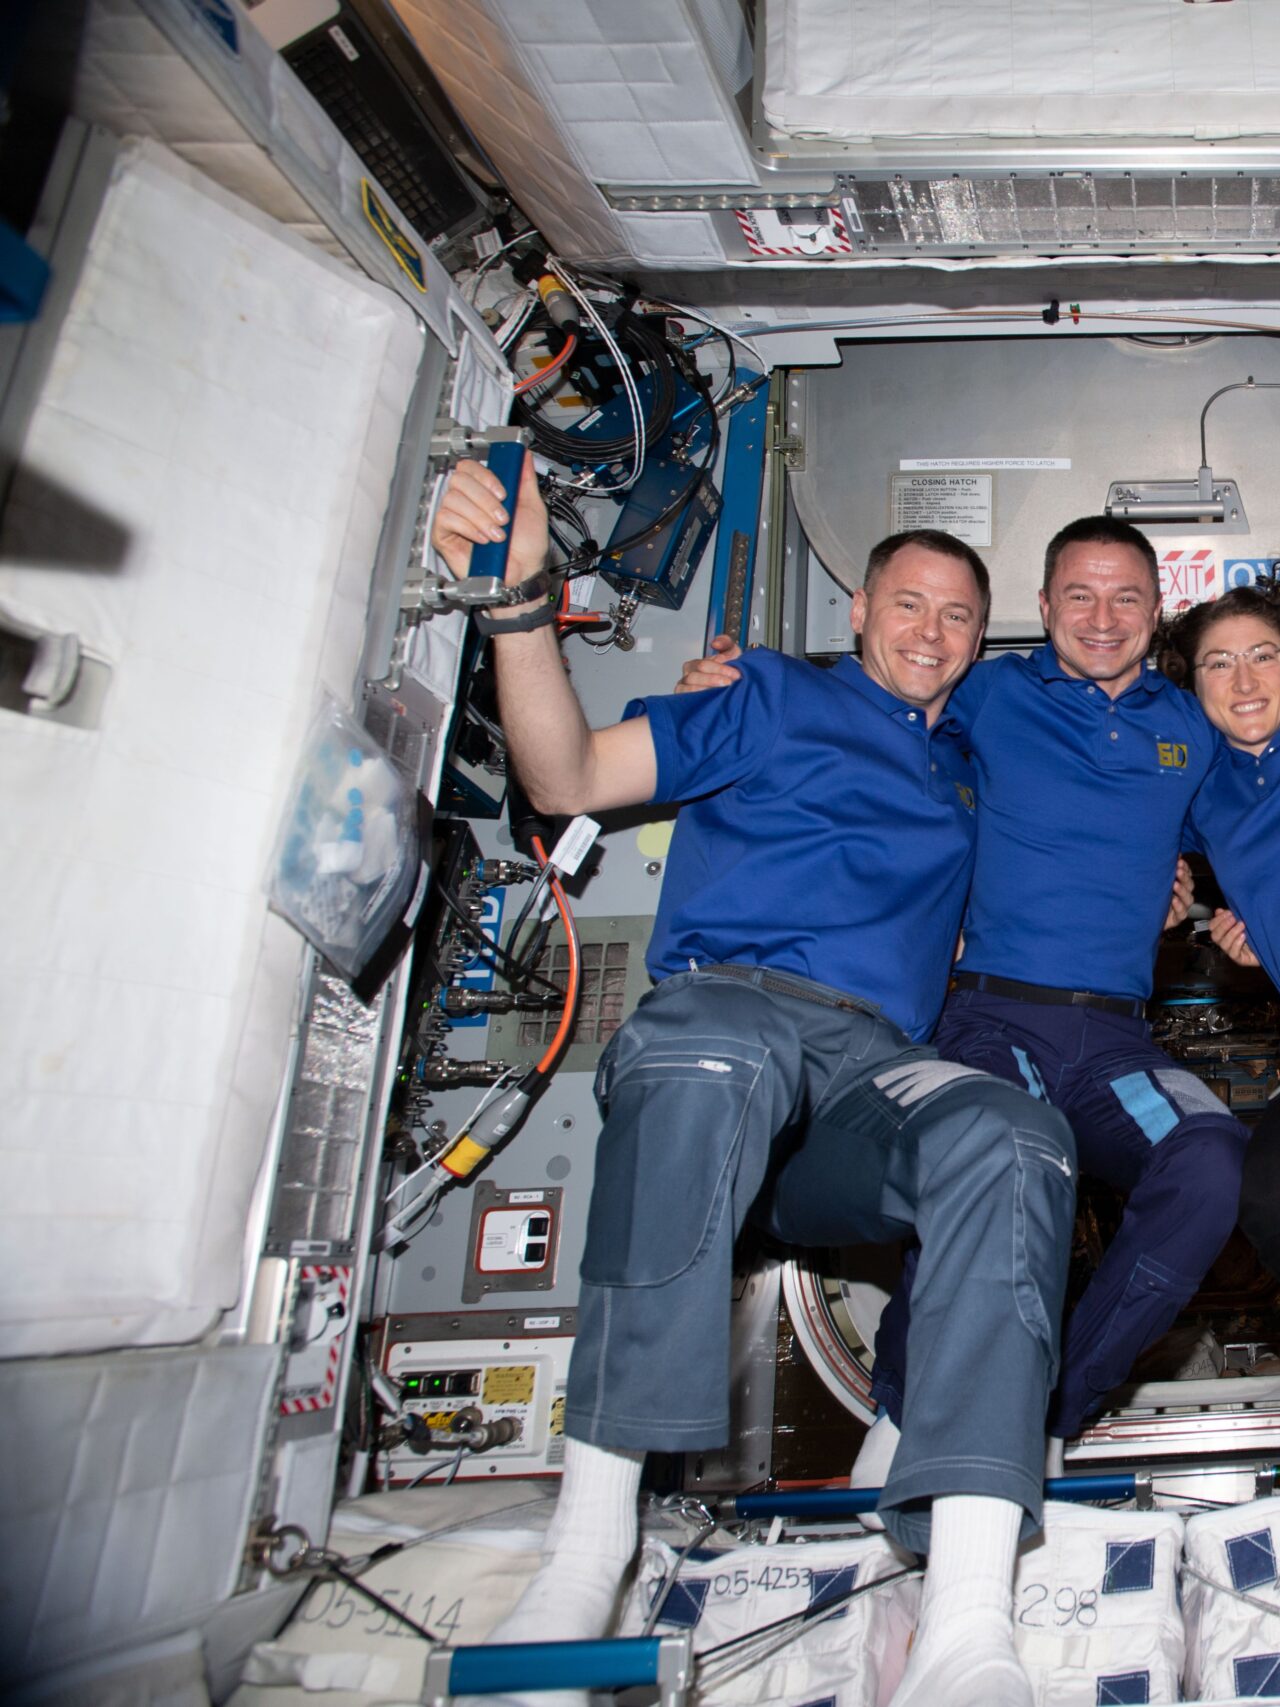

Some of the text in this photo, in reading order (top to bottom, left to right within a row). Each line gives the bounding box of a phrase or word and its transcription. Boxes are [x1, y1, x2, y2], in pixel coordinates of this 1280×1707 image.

[911, 478, 977, 486] CLOSING HATCH
[1158, 564, 1204, 596] EXIT
[1018, 1583, 1098, 1628] 298
